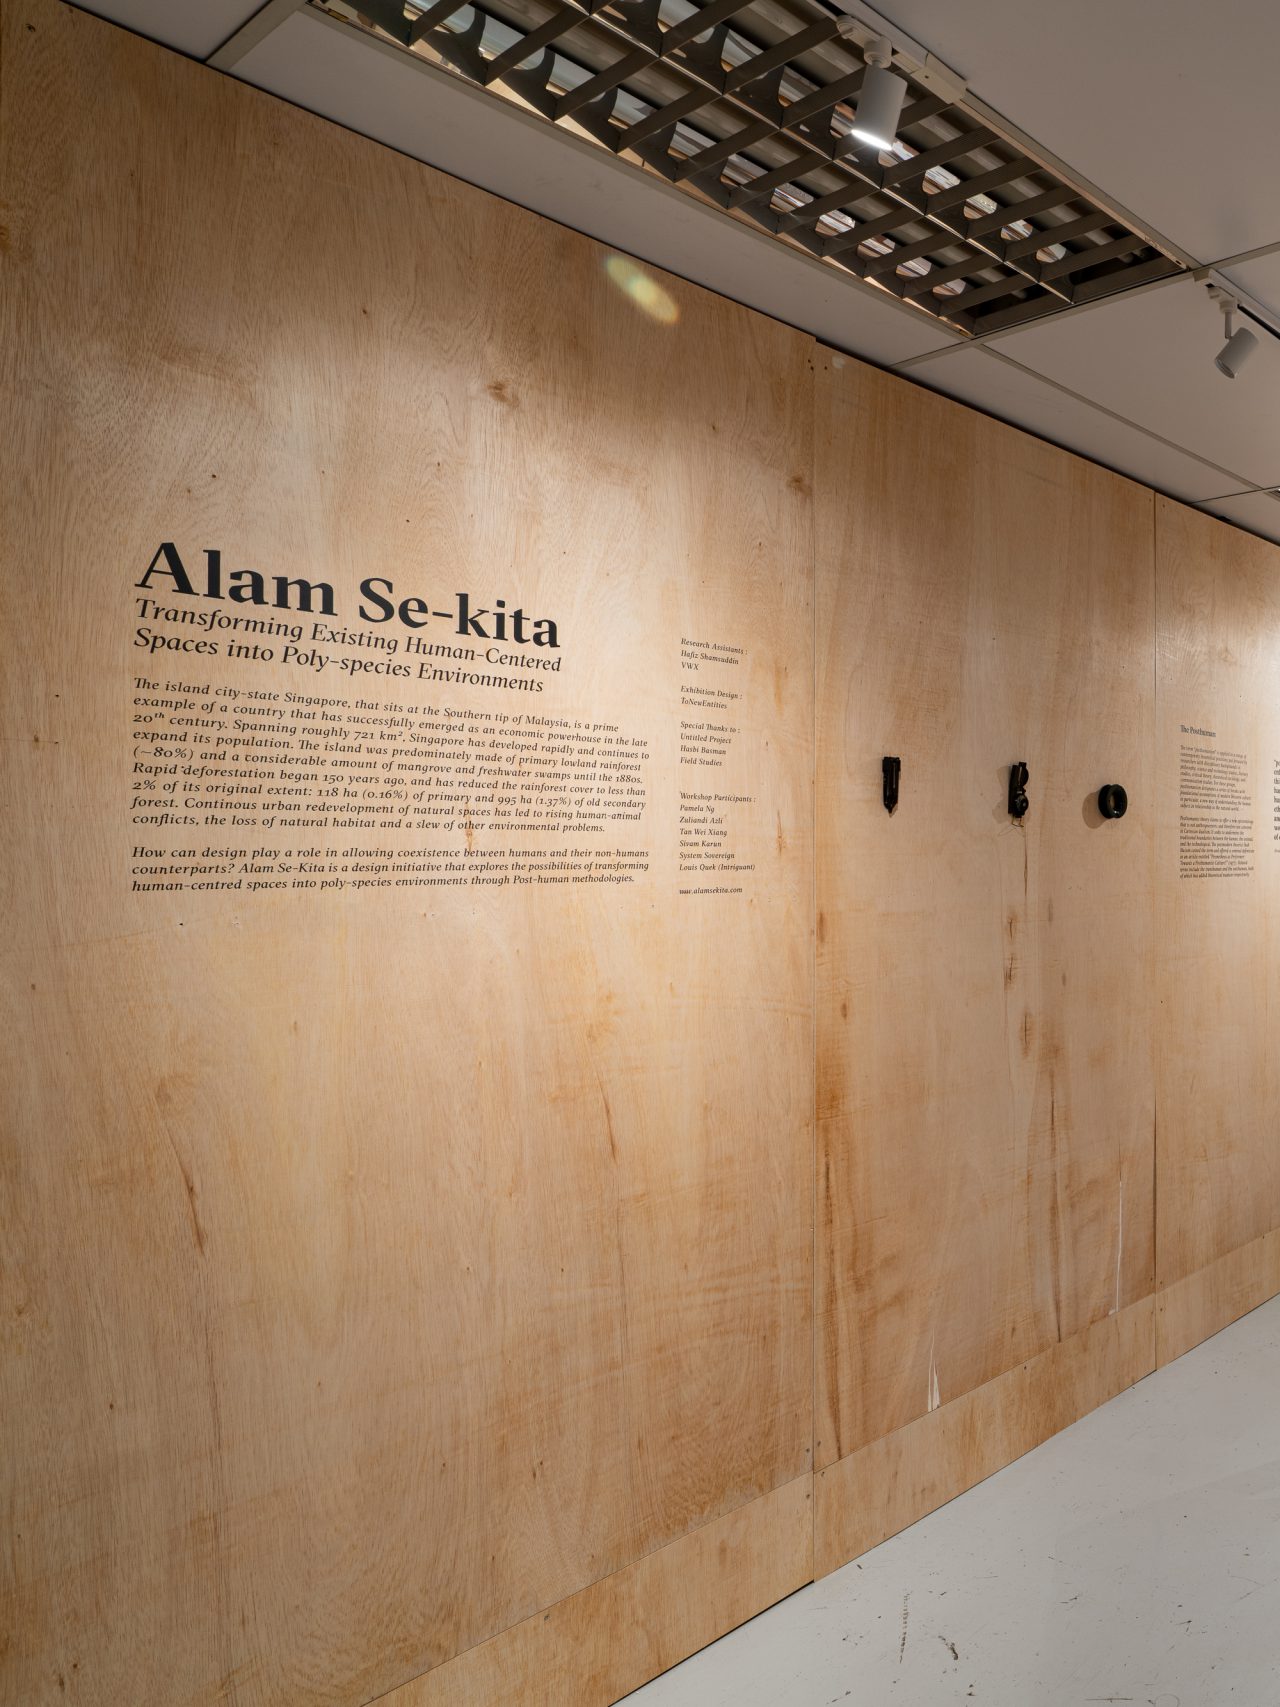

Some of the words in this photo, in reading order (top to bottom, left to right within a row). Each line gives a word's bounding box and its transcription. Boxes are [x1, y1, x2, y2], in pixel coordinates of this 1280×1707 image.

[134, 542, 338, 616] Alam
[359, 578, 560, 648] Se-kita
[136, 598, 303, 643] Transforming
[311, 623, 398, 655] Existing
[405, 636, 561, 672] Human-Centered
[681, 638, 710, 649] Research
[712, 643, 743, 655] Assistants
[134, 628, 218, 654] Spaces
[228, 640, 273, 661] into
[281, 646, 411, 677] Poly-species
[417, 663, 543, 692] Environments
[681, 650, 699, 660] Hafiz
[682, 662, 699, 670] VWX
[681, 685, 716, 696] Exhibition
[717, 690, 738, 700] Design
[134, 678, 159, 689] The
[166, 681, 210, 694] island
[216, 687, 279, 700] city-state
[284, 693, 350, 708] Singapore,
[356, 700, 379, 710] that
[384, 703, 403, 712] sits
[423, 706, 439, 715] the
[444, 708, 491, 720] Southern
[496, 714, 508, 724] tip
[512, 715, 523, 725] of
[526, 716, 570, 728] Malaysia,
[681, 696, 727, 709] ToNewEntities
[134, 698, 195, 711] example
[202, 702, 216, 714] of
[234, 707, 285, 719] country
[291, 709, 316, 719] that
[322, 711, 342, 721] has
[347, 716, 415, 730] successfully
[419, 722, 464, 733] emerged
[499, 730, 544, 738] economic
[548, 733, 601, 743] powerhouse
[680, 721, 704, 730] Special
[706, 724, 728, 732] Thanks
[170, 718, 227, 730] century.
[233, 720, 296, 736] Spanning
[302, 727, 349, 740] roughly
[354, 732, 373, 740] 721
[409, 733, 464, 746] Singapore
[468, 738, 485, 747] has
[489, 740, 537, 752] developed
[542, 745, 574, 756] rapidly
[681, 733, 708, 742] Untitled
[709, 736, 732, 745] Project
[680, 756, 697, 764] Field
[699, 758, 722, 766] Studies
[680, 791, 712, 802] Workshop
[714, 794, 752, 803] Participants
[706, 805, 714, 814] Ng
[708, 829, 727, 838] Xiang
[679, 851, 702, 861] System
[704, 852, 735, 861] Sovereign
[132, 879, 242, 891] human-centred
[247, 882, 287, 891] spaces
[292, 879, 316, 888] into
[321, 878, 391, 890] poly-species
[396, 877, 467, 886] environments
[472, 876, 509, 886] through
[514, 875, 568, 884] Post-human
[572, 874, 634, 884] methodologies.
